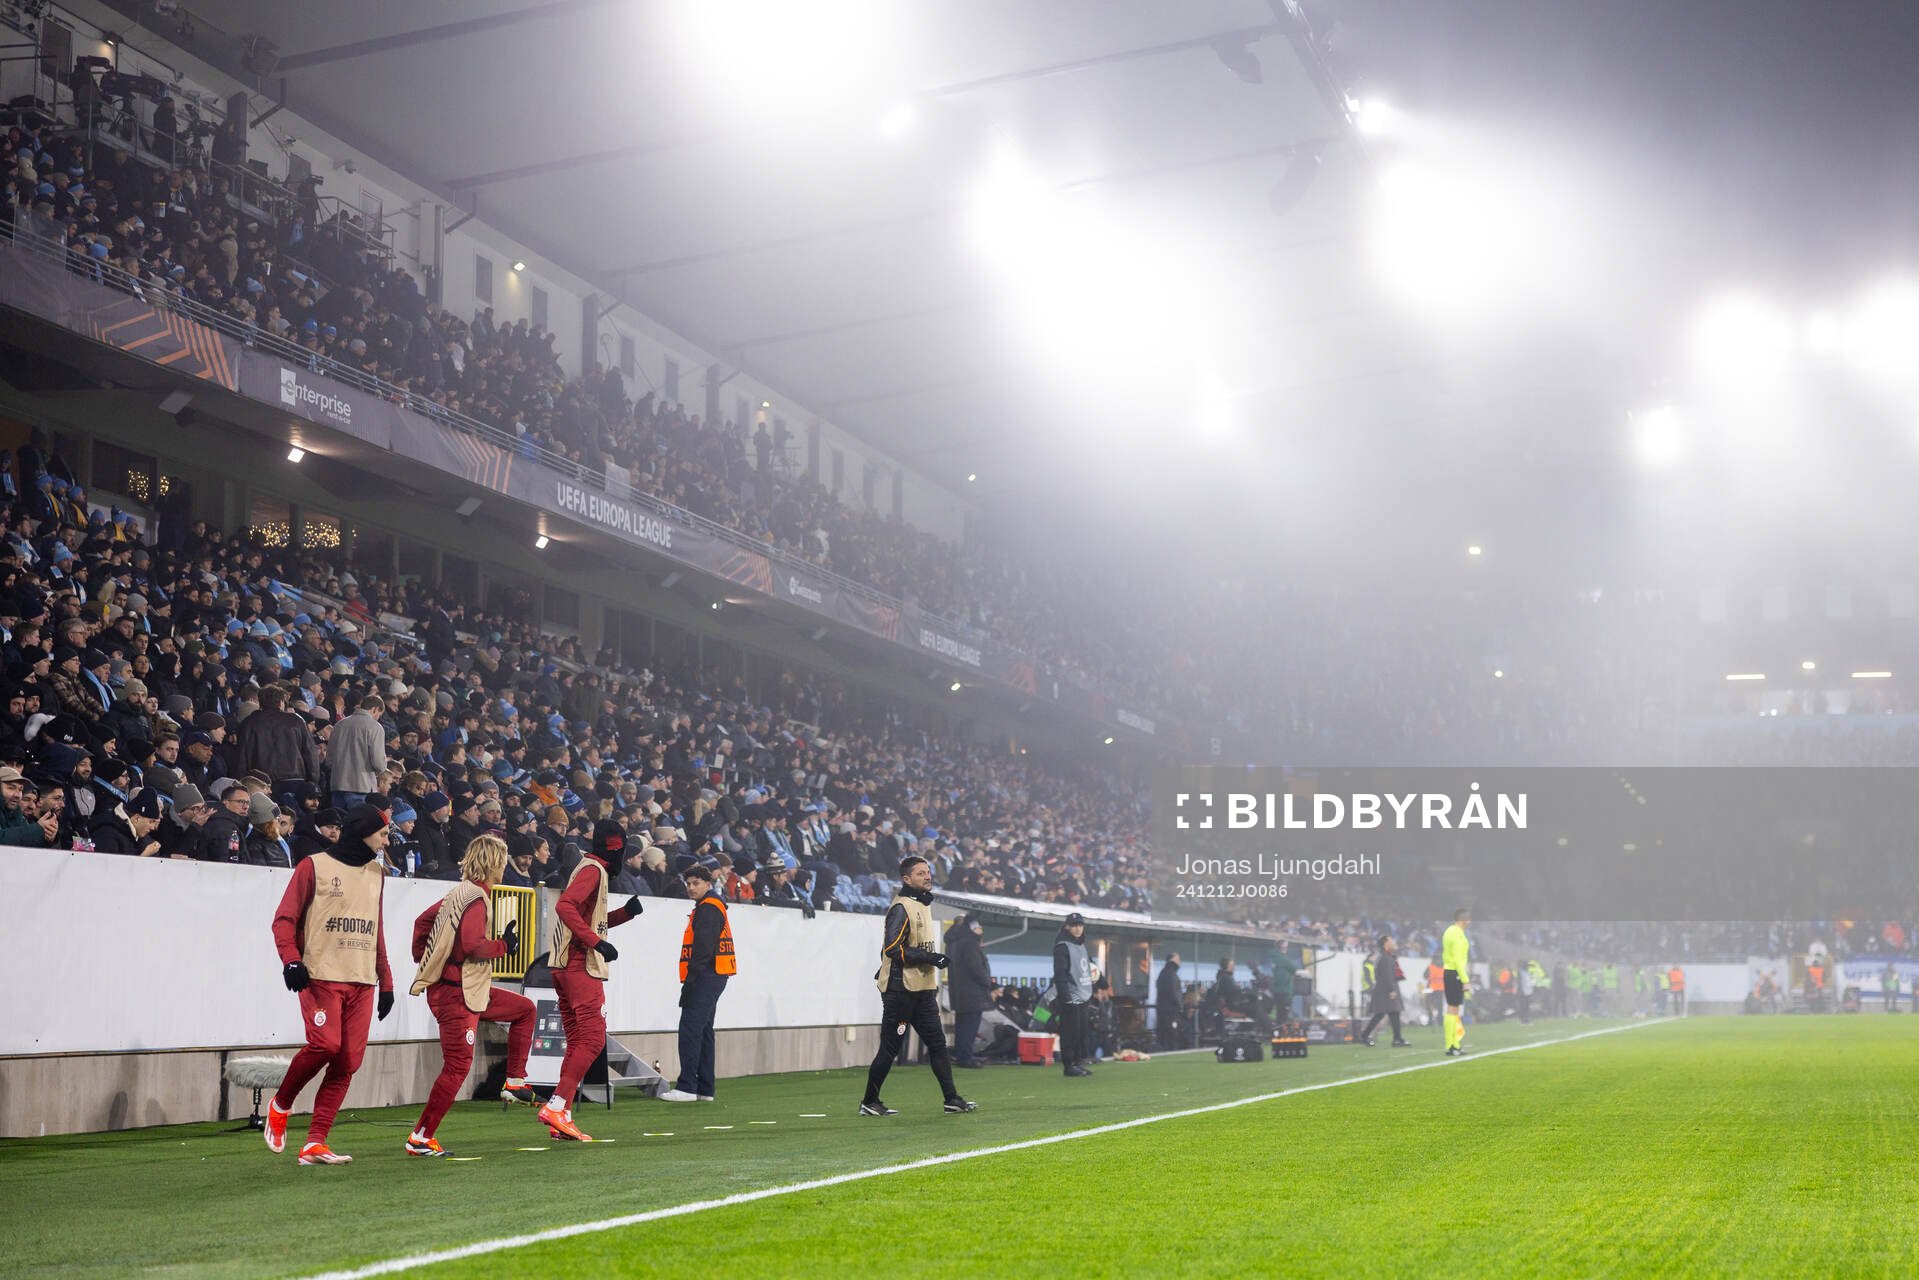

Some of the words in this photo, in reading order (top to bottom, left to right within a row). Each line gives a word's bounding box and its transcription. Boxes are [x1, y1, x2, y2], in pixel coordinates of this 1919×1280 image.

[281, 379, 352, 417] enterprise
[557, 481, 587, 516] UEFA
[590, 495, 631, 533] EUROPA
[633, 513, 672, 548] LEAGUE
